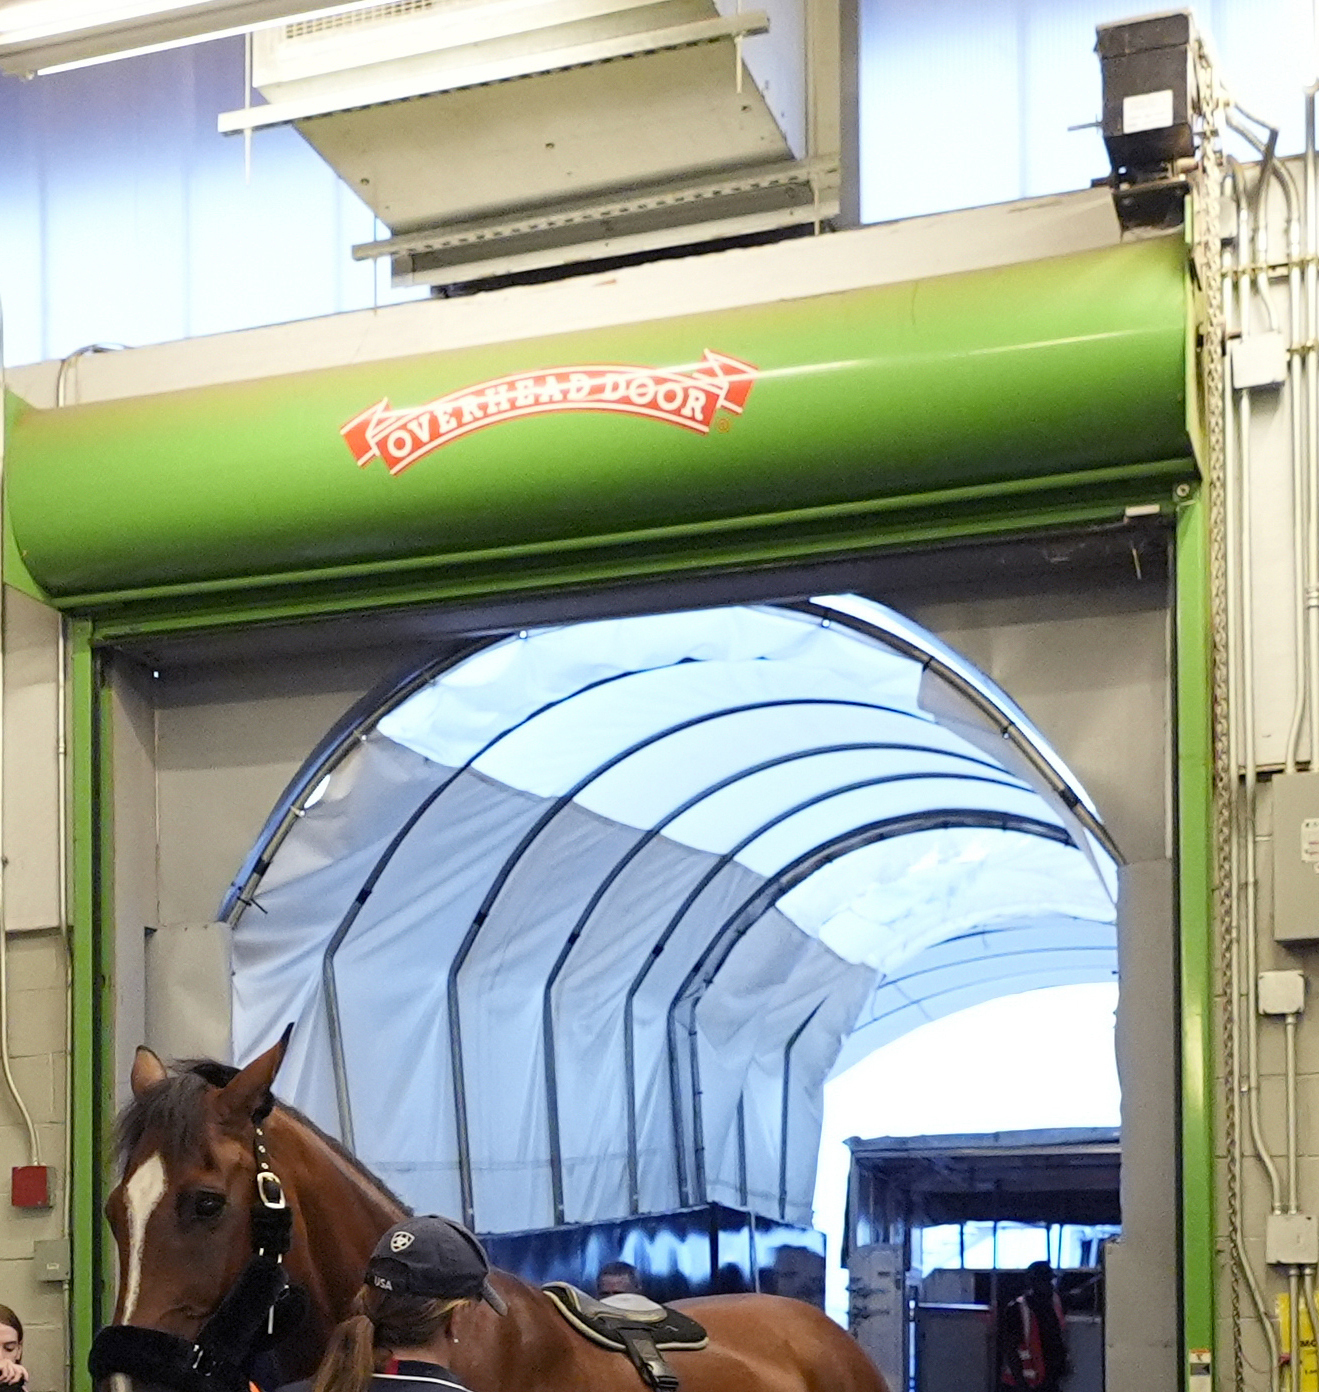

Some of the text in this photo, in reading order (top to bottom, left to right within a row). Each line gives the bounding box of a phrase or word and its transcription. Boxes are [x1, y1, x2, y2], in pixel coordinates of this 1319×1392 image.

[386, 370, 707, 460] OVERHEAD DOOR
[373, 1276, 393, 1291] USA
